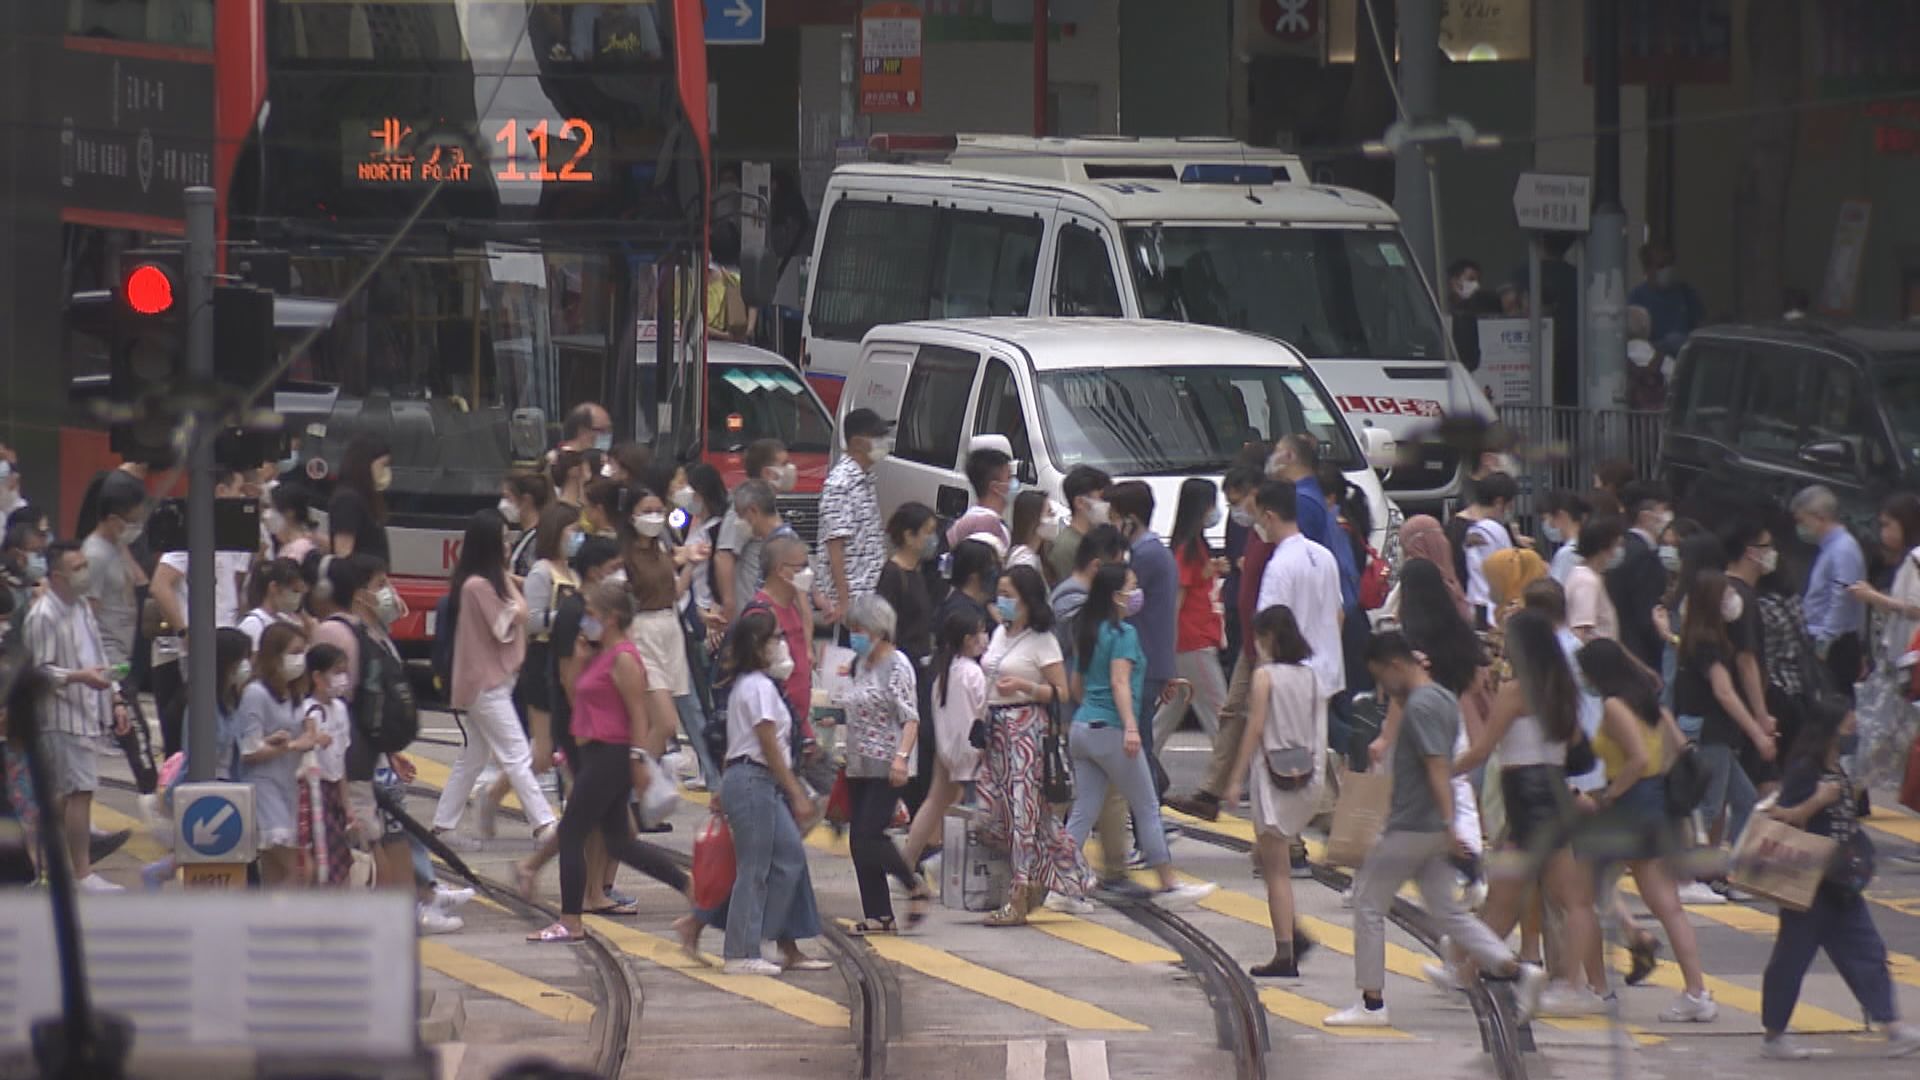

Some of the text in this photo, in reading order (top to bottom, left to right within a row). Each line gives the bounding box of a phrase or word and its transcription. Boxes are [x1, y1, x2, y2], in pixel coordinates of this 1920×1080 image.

[495, 117, 594, 182] 112
[358, 163, 412, 180] NORTH
[1342, 396, 1416, 416] LICE
